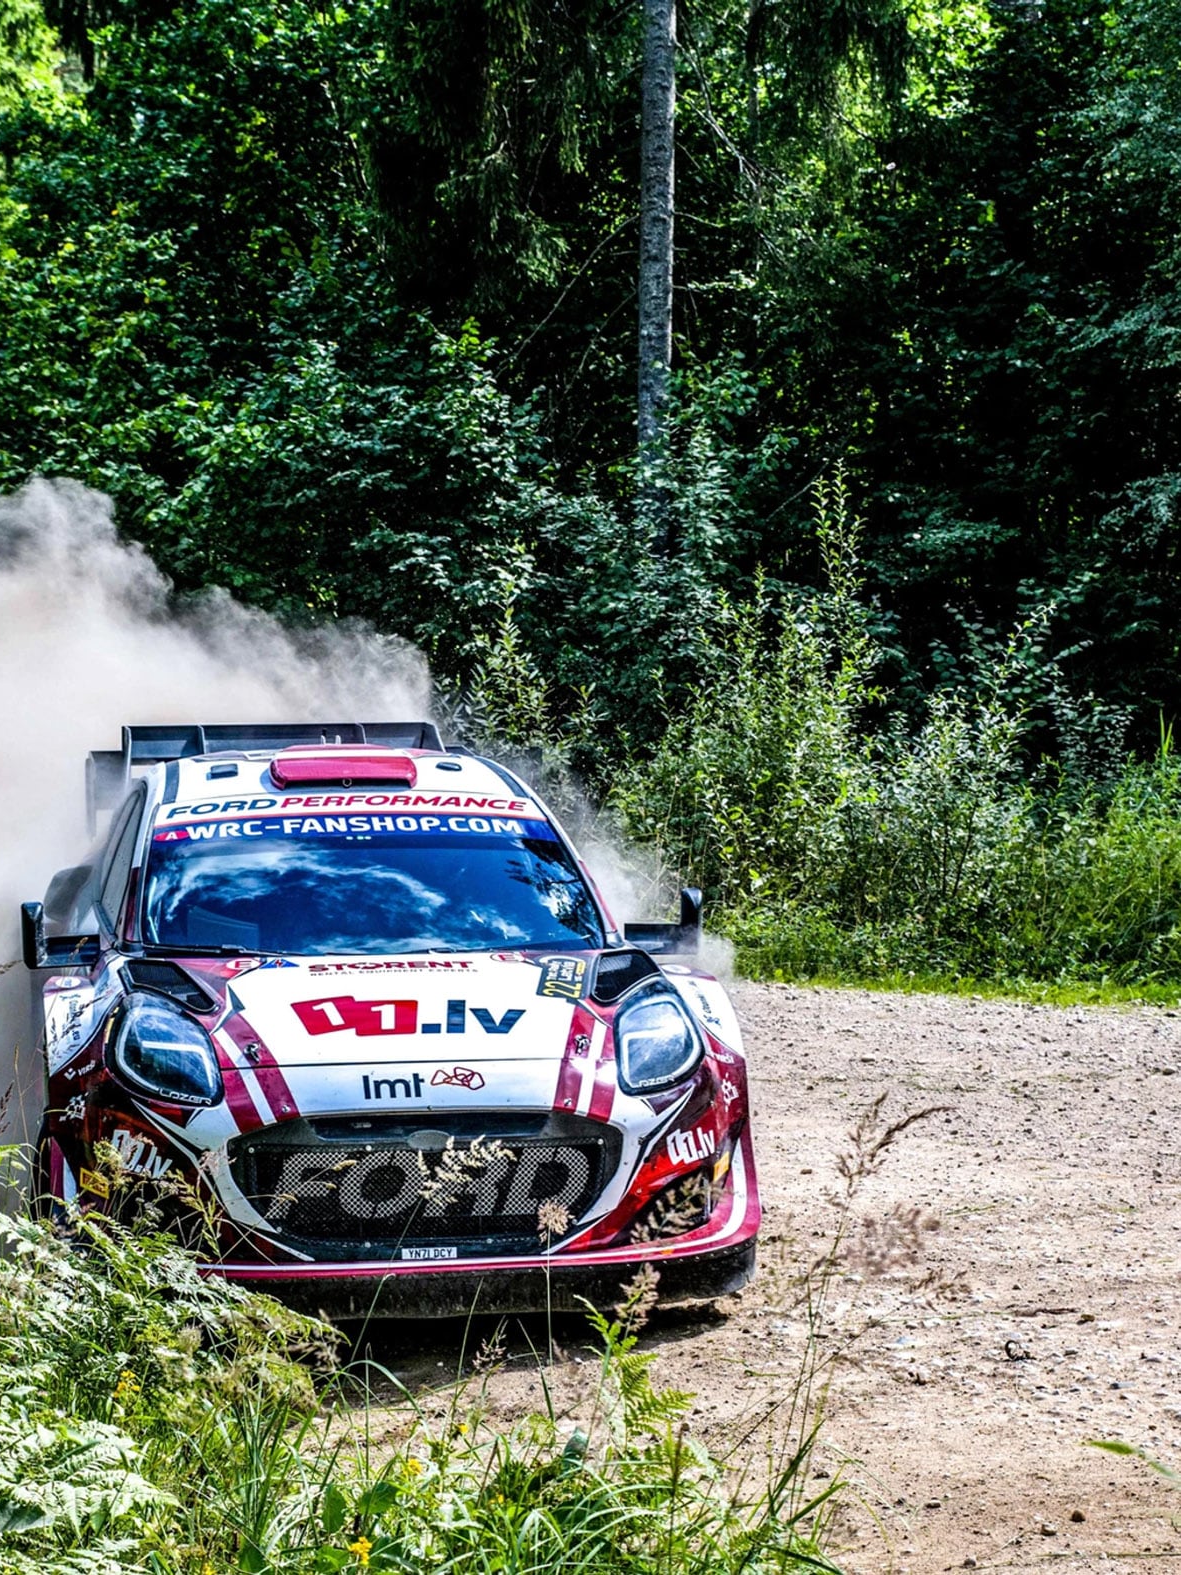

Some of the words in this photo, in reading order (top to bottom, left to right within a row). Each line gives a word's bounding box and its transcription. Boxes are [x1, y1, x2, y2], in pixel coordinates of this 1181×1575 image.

[167, 799, 277, 820] FORD
[281, 795, 527, 812] PERFORMANCE
[185, 815, 524, 842] WRC-FANSHOP.COM
[308, 960, 473, 973] STORENT
[542, 980, 583, 999] 22
[293, 998, 527, 1036] 11.lv
[362, 1072, 425, 1101] lmt
[665, 1126, 716, 1165] 11.lv
[263, 1145, 591, 1219] FORD
